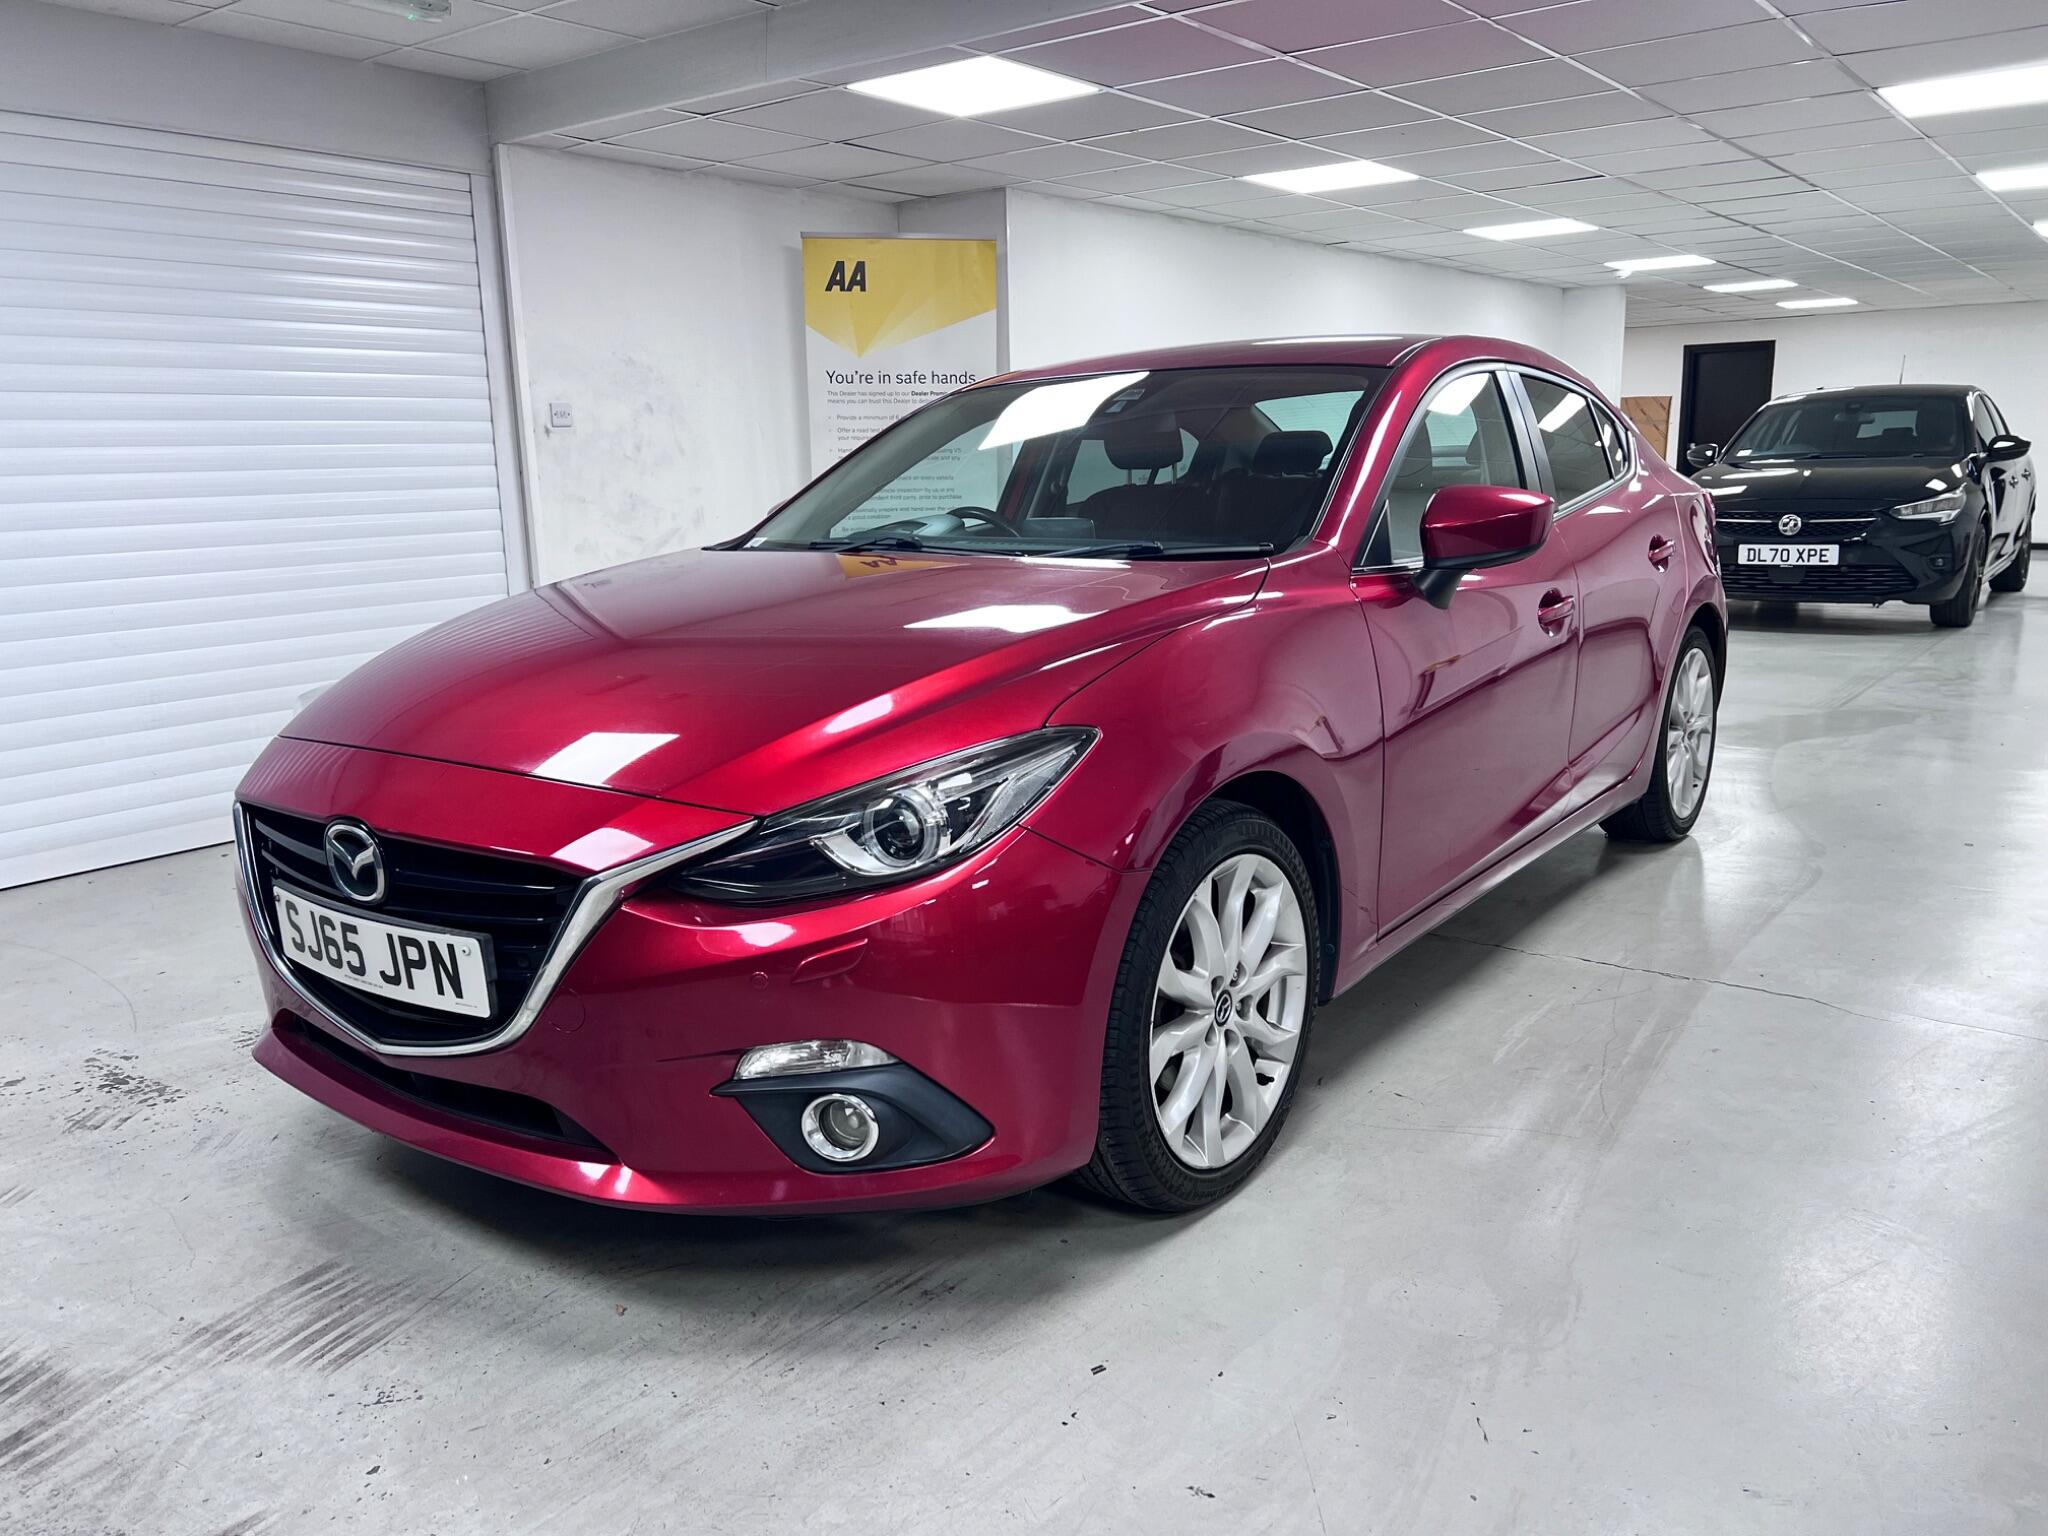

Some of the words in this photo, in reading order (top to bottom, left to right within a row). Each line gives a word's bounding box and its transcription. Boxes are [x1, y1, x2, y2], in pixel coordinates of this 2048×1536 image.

[825, 260, 866, 292] AA
[826, 370, 873, 385] You're
[878, 370, 891, 385] in
[895, 370, 926, 385] safe
[931, 370, 976, 385] hands
[1747, 548, 1790, 563] DL70
[1796, 548, 1830, 563] XPE
[285, 900, 366, 977] SJ65
[380, 933, 464, 1000] JPN
